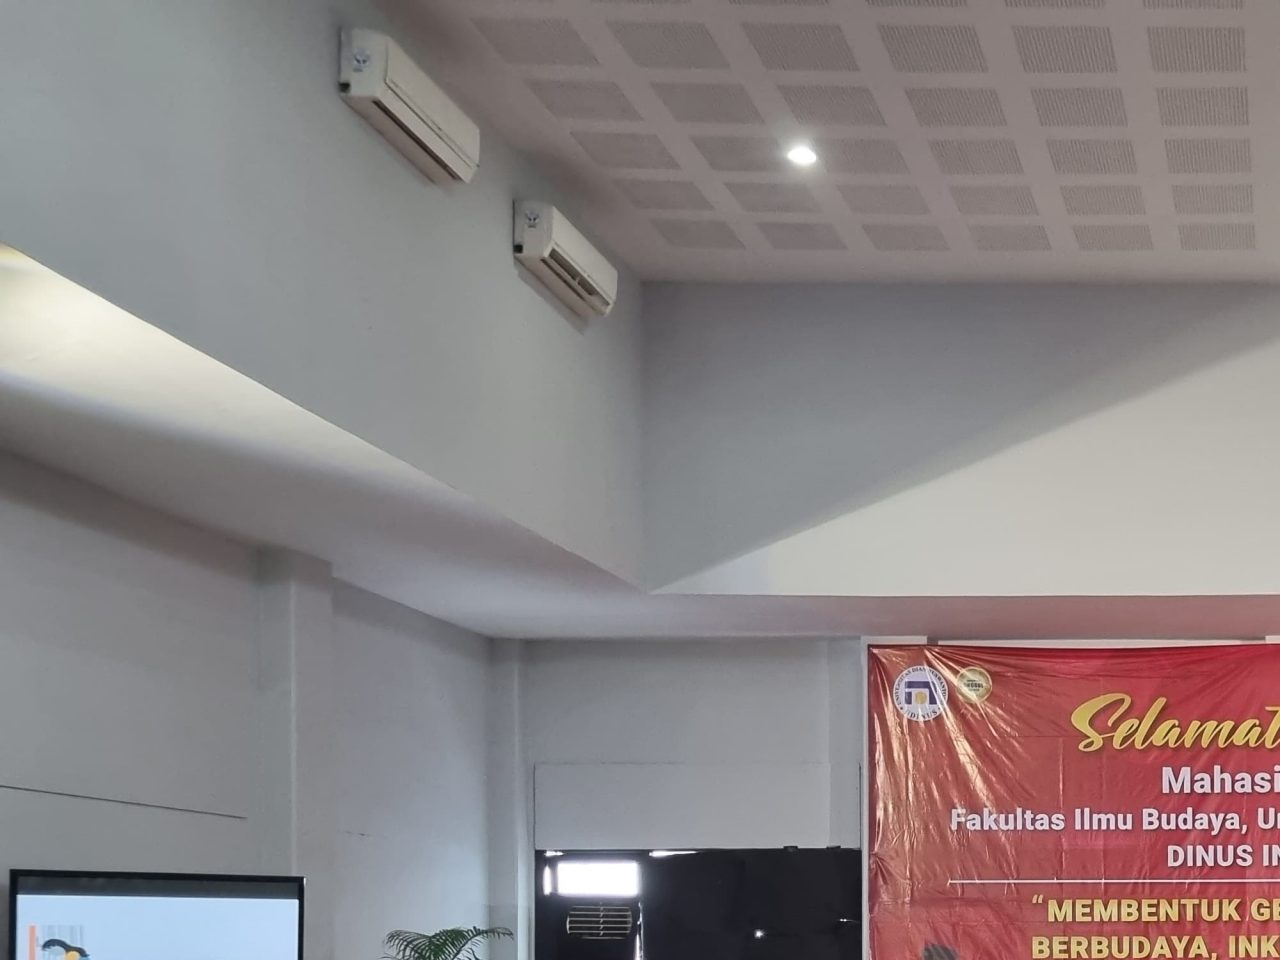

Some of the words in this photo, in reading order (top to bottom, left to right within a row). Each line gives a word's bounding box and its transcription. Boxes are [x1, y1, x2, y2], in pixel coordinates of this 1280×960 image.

[950, 807, 1065, 831] Fakultas
[1074, 807, 1133, 831] Ilmu
[1142, 807, 1248, 836] Budaya,
[1166, 845, 1253, 868] DINUS
